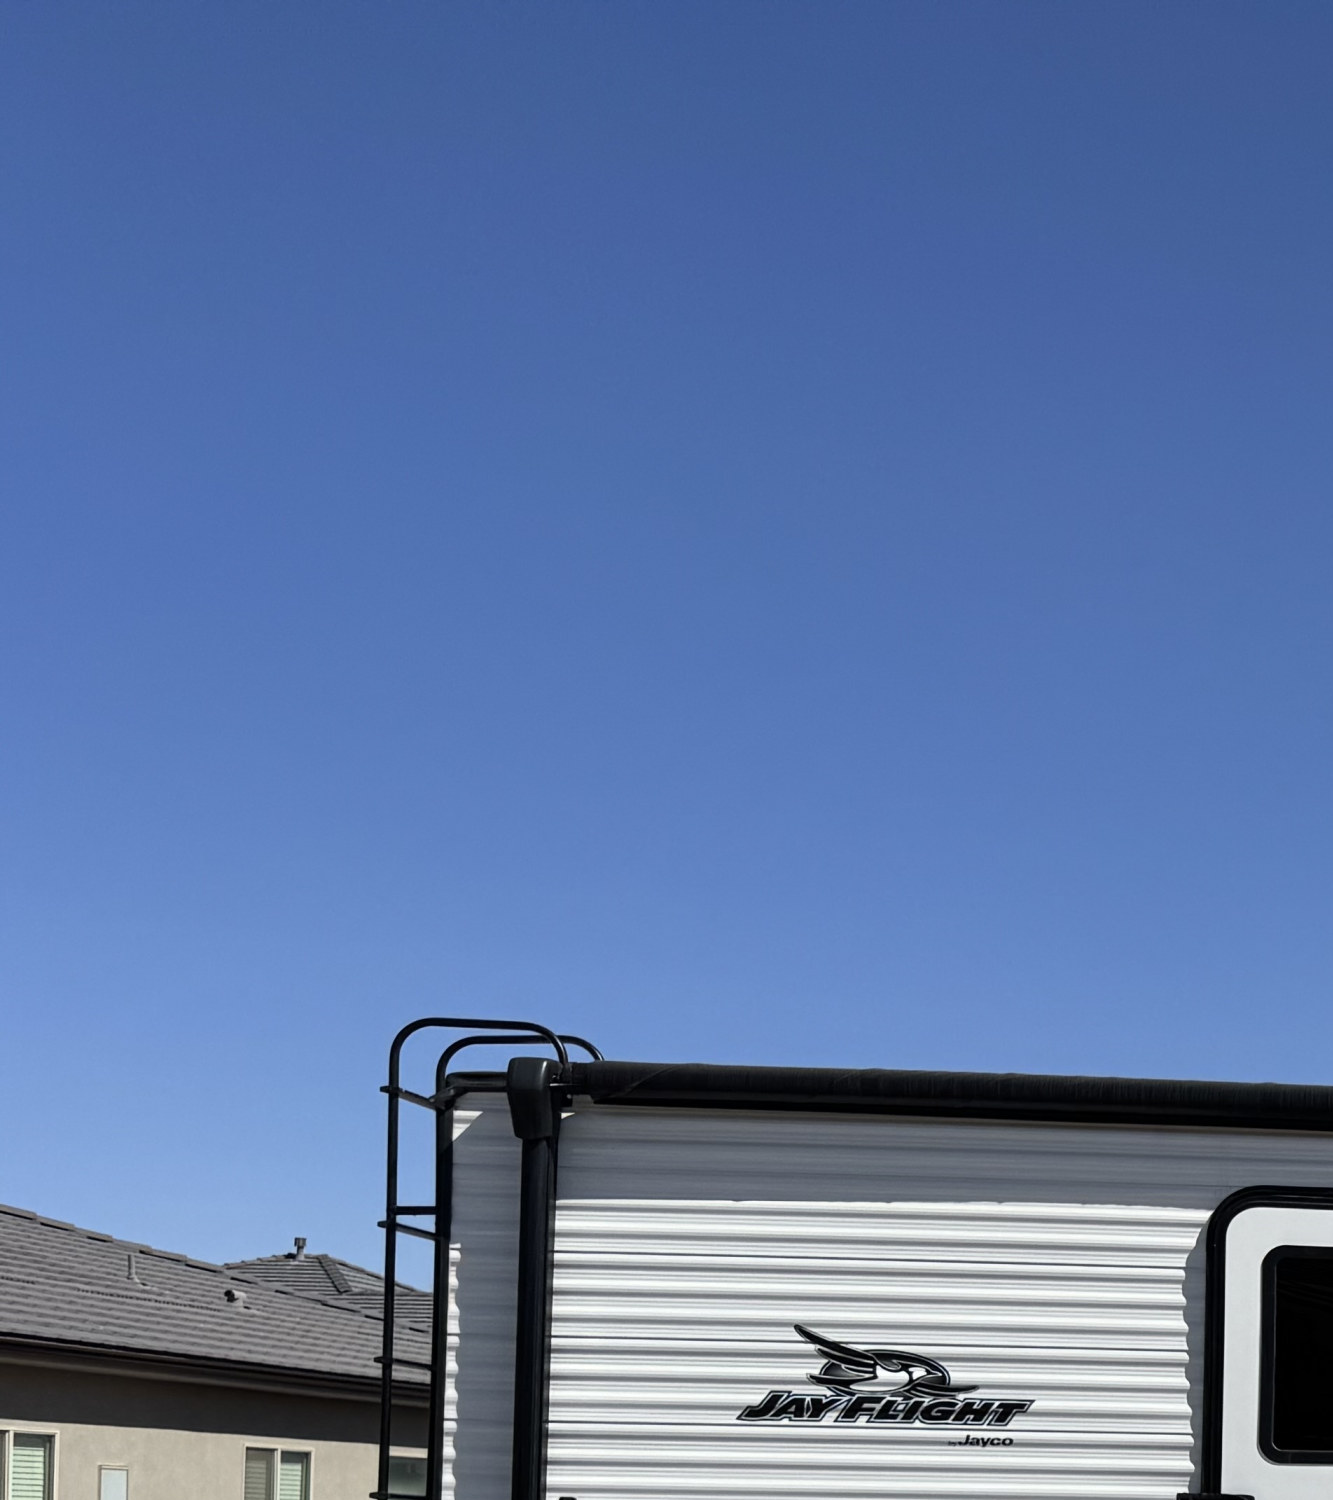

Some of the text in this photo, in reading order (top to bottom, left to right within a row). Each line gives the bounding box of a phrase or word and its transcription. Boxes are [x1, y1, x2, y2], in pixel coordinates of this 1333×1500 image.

[737, 1391, 1036, 1426] JAY FLIGHT
[959, 1434, 1014, 1448] Jayco
